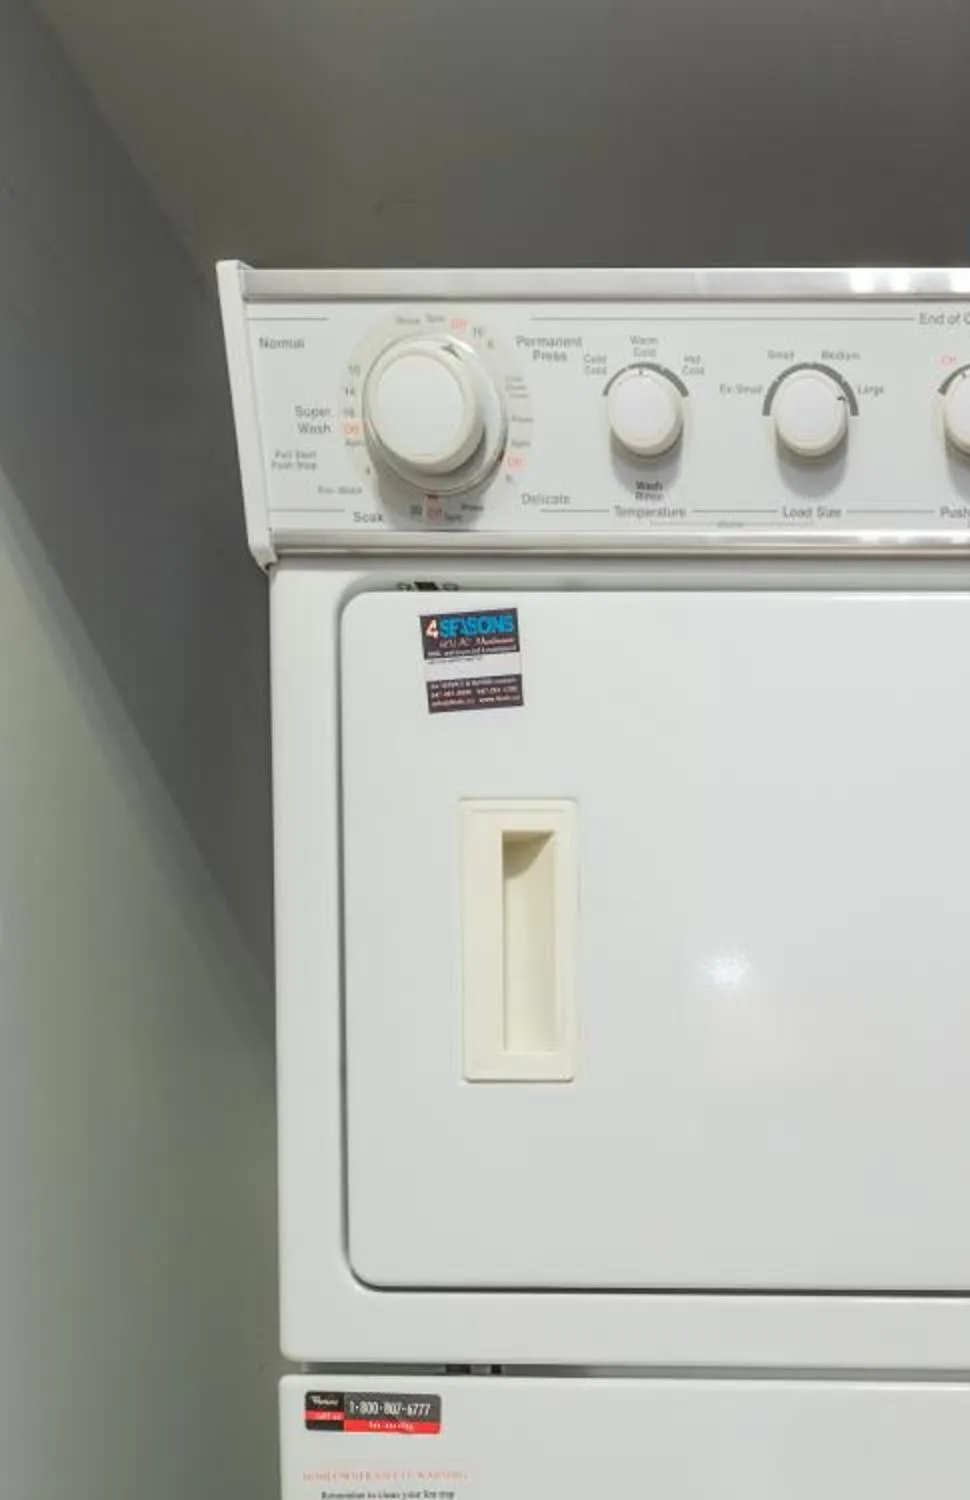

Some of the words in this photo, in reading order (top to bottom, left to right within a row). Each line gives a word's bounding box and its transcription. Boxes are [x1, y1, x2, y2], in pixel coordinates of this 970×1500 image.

[919, 313, 944, 325] End
[947, 313, 960, 325] of
[259, 336, 305, 350] Normal
[515, 335, 582, 348] Permanent
[629, 335, 659, 346] Warm
[533, 350, 567, 362] Press
[344, 387, 356, 397] 14
[856, 384, 885, 397] Large
[295, 405, 331, 420] Super
[297, 423, 331, 434] Wash
[635, 480, 663, 492] Wash
[521, 493, 571, 506] Delicate
[353, 511, 384, 524] Soak
[614, 505, 686, 519] Temperature
[782, 506, 813, 518] Load
[817, 506, 842, 518] Size
[940, 506, 970, 519] Push
